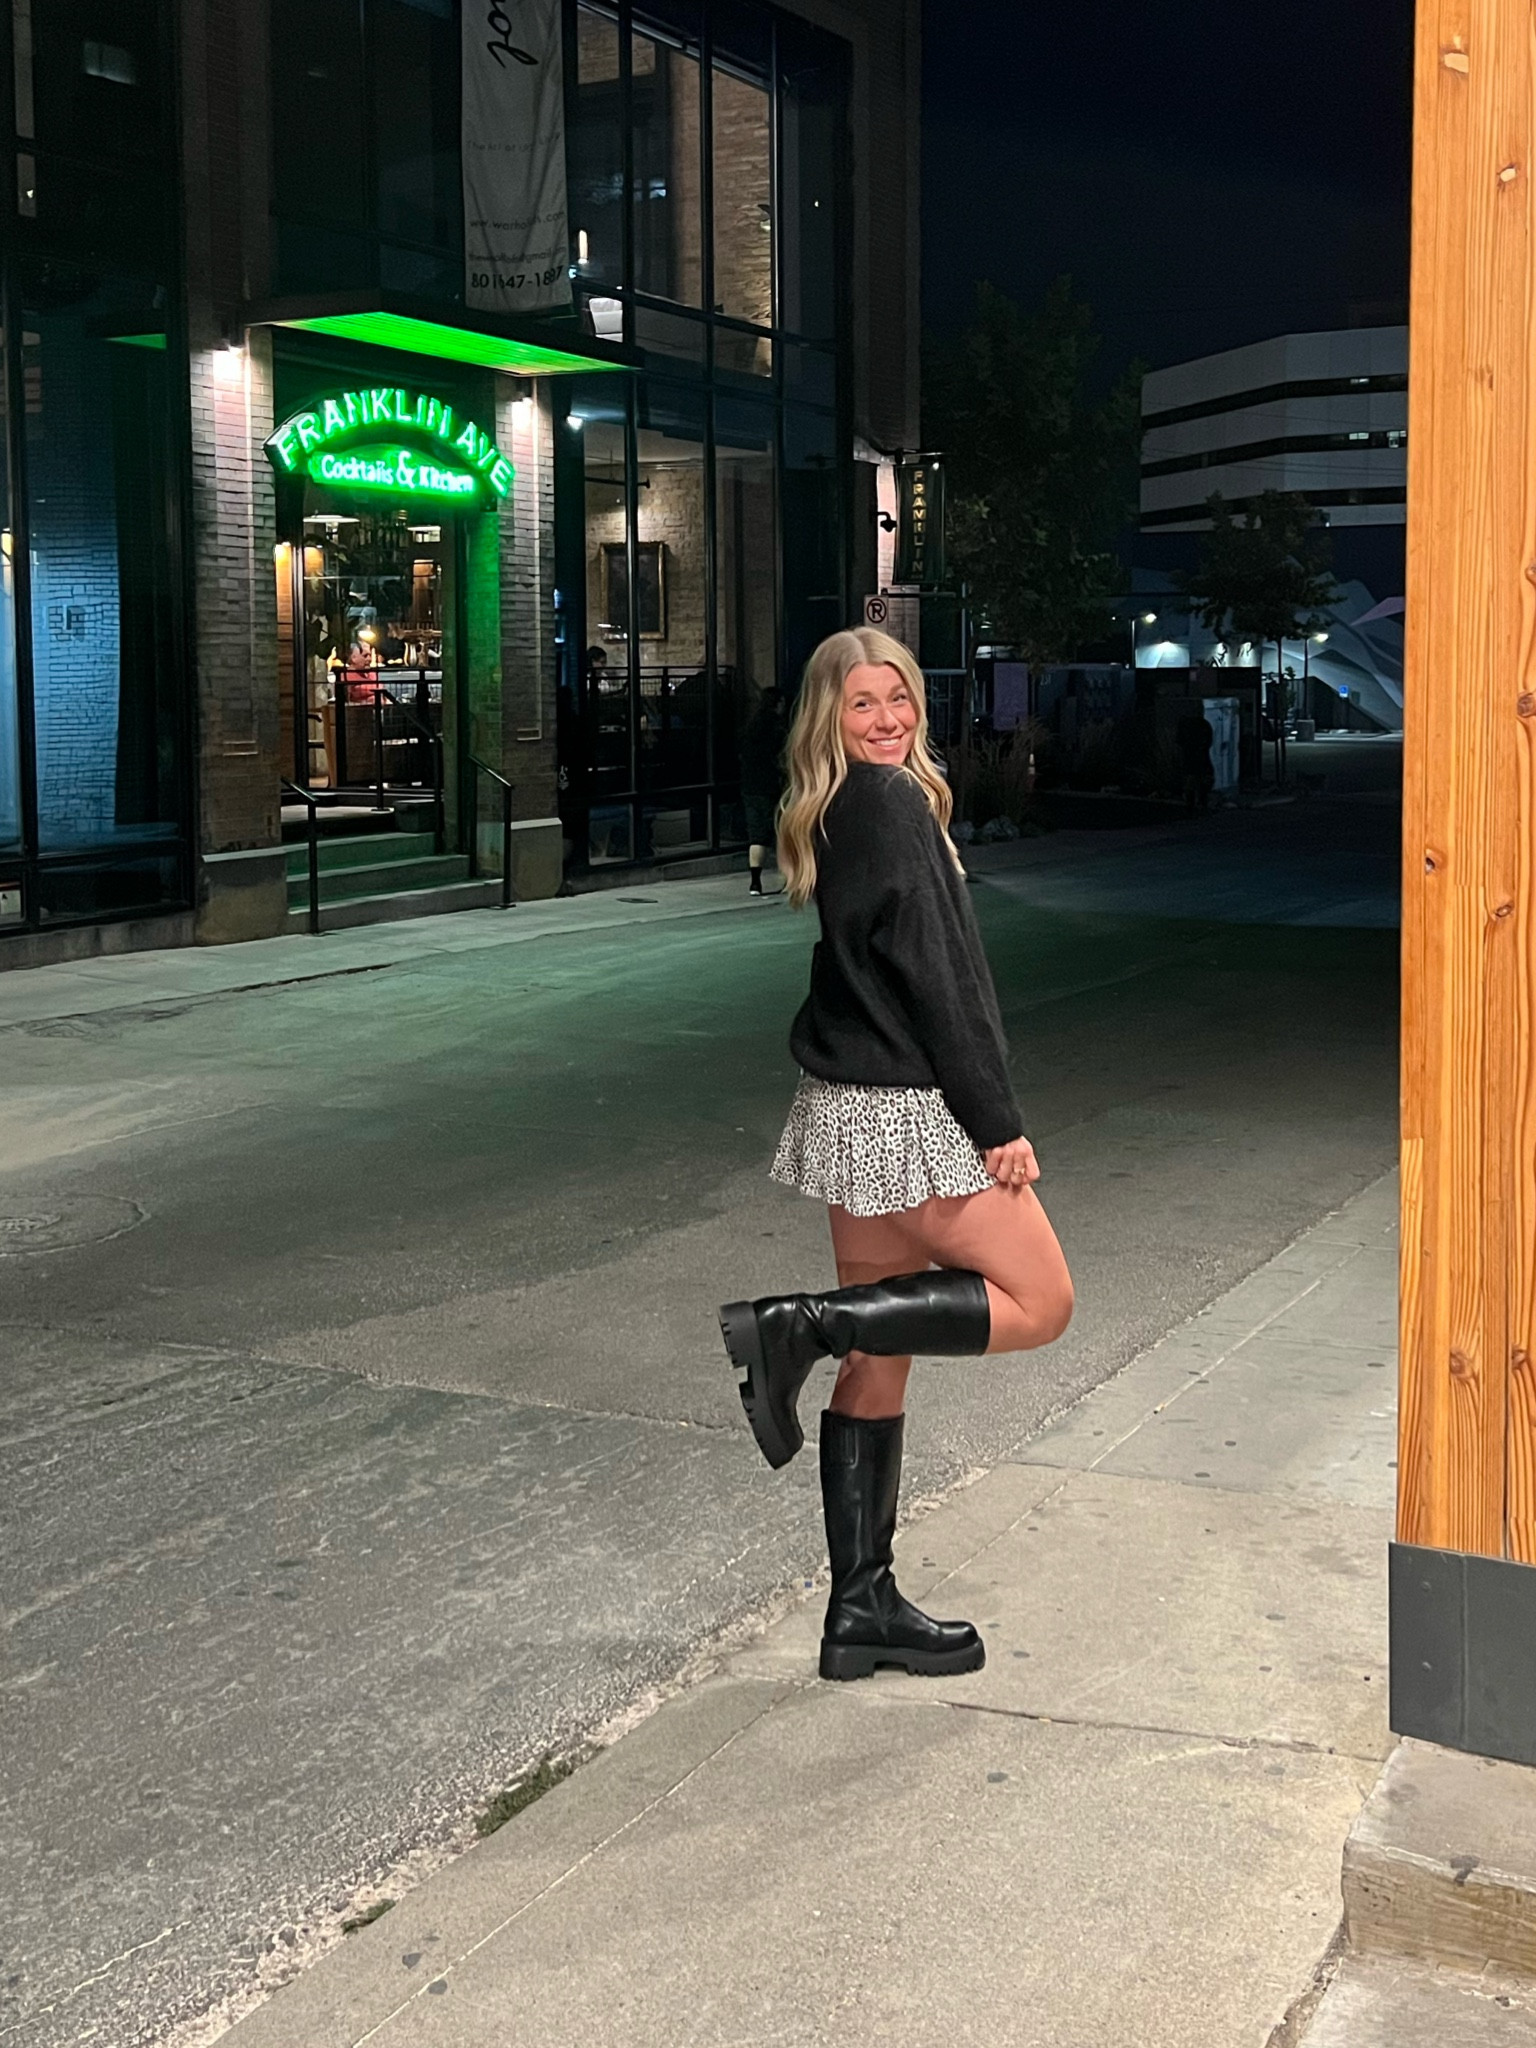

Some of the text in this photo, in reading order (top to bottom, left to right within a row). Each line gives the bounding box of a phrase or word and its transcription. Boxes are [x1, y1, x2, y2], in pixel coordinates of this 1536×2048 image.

[266, 387, 516, 497] FRANKLIN AVE
[321, 450, 474, 493] Cocktails & Kitchen
